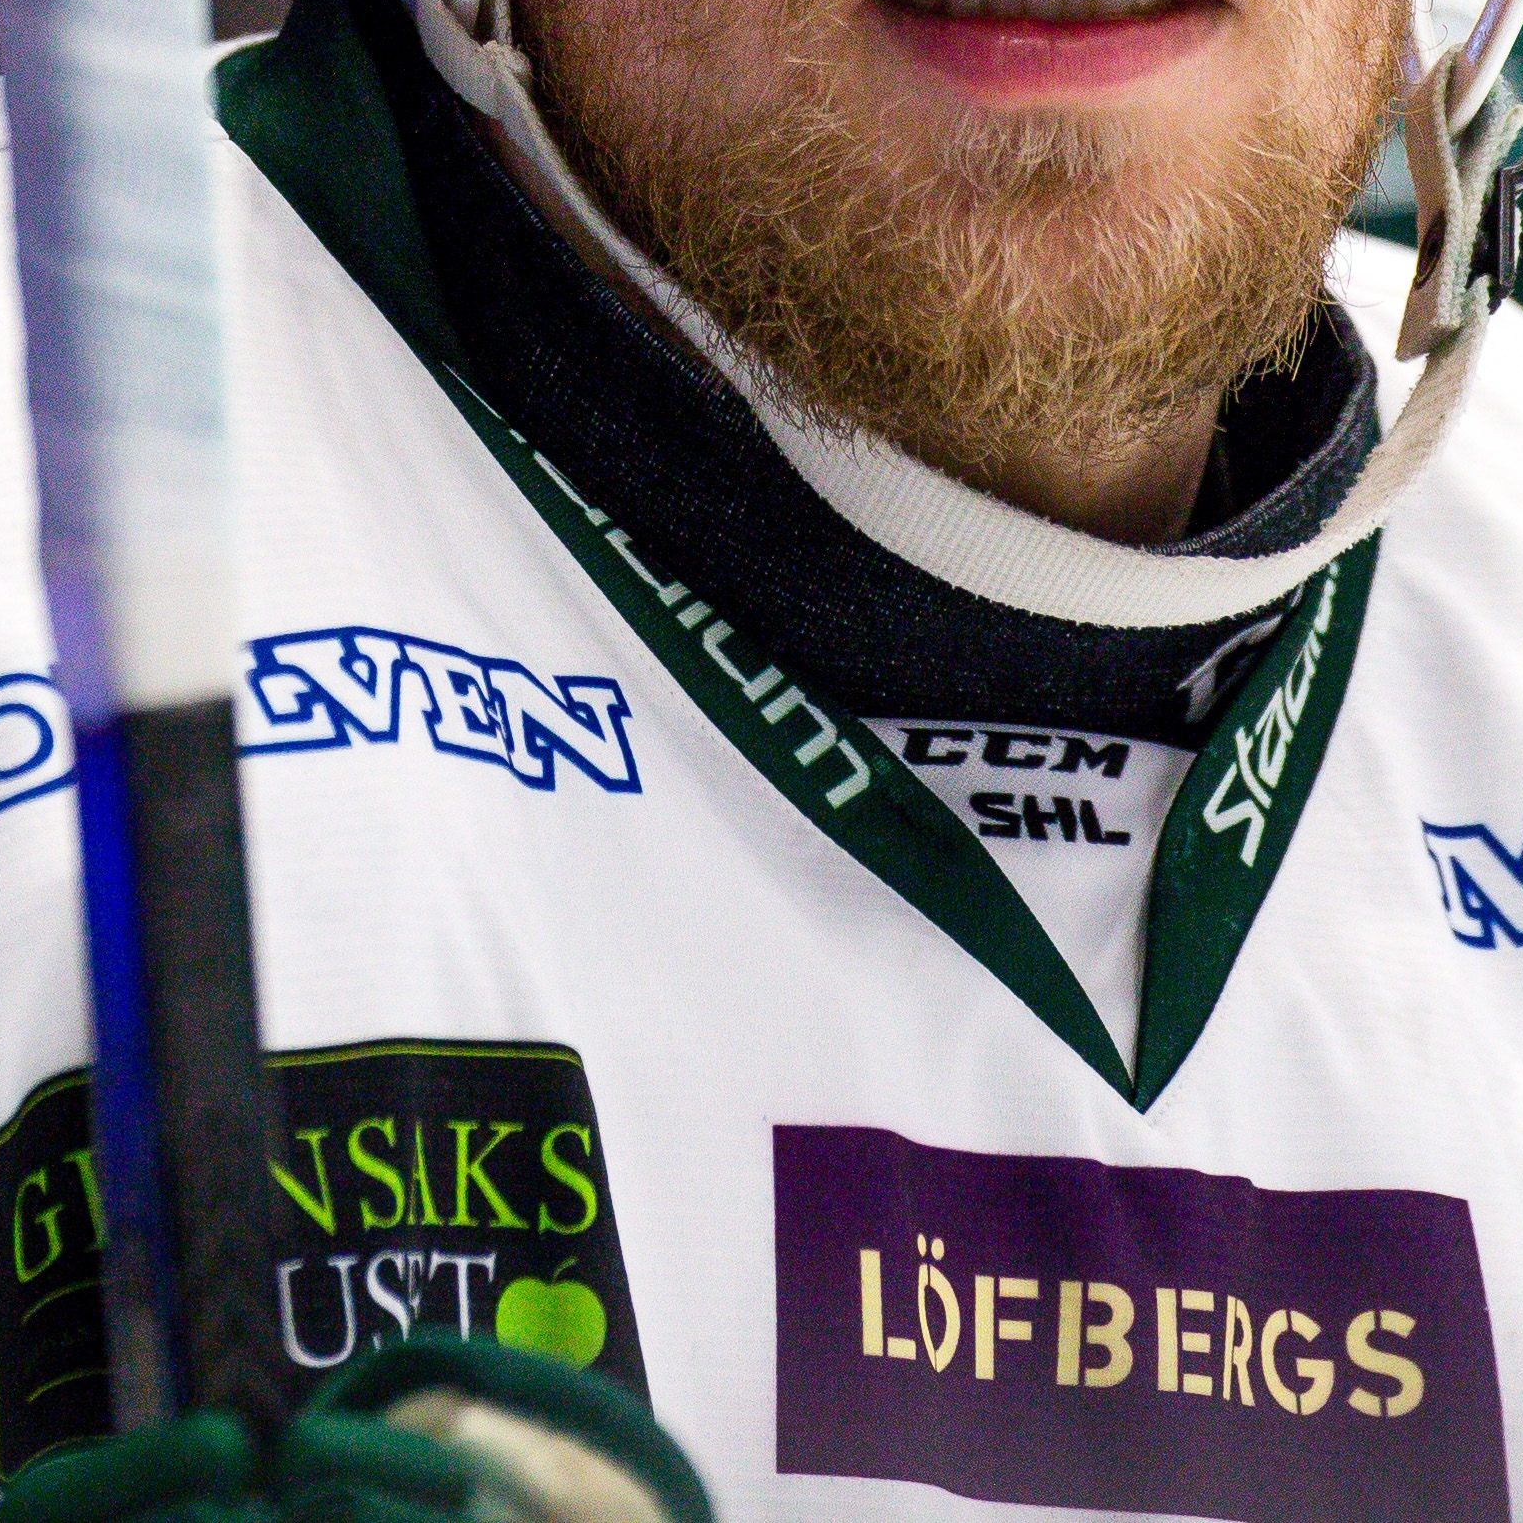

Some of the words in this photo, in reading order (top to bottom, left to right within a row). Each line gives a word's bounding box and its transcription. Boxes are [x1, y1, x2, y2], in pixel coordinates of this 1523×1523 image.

[901, 727, 1131, 780] CCM
[970, 791, 1132, 847] SHL
[13, 1117, 599, 1283] GNSAKS
[859, 1234, 1426, 1420] LÖFBERGS
